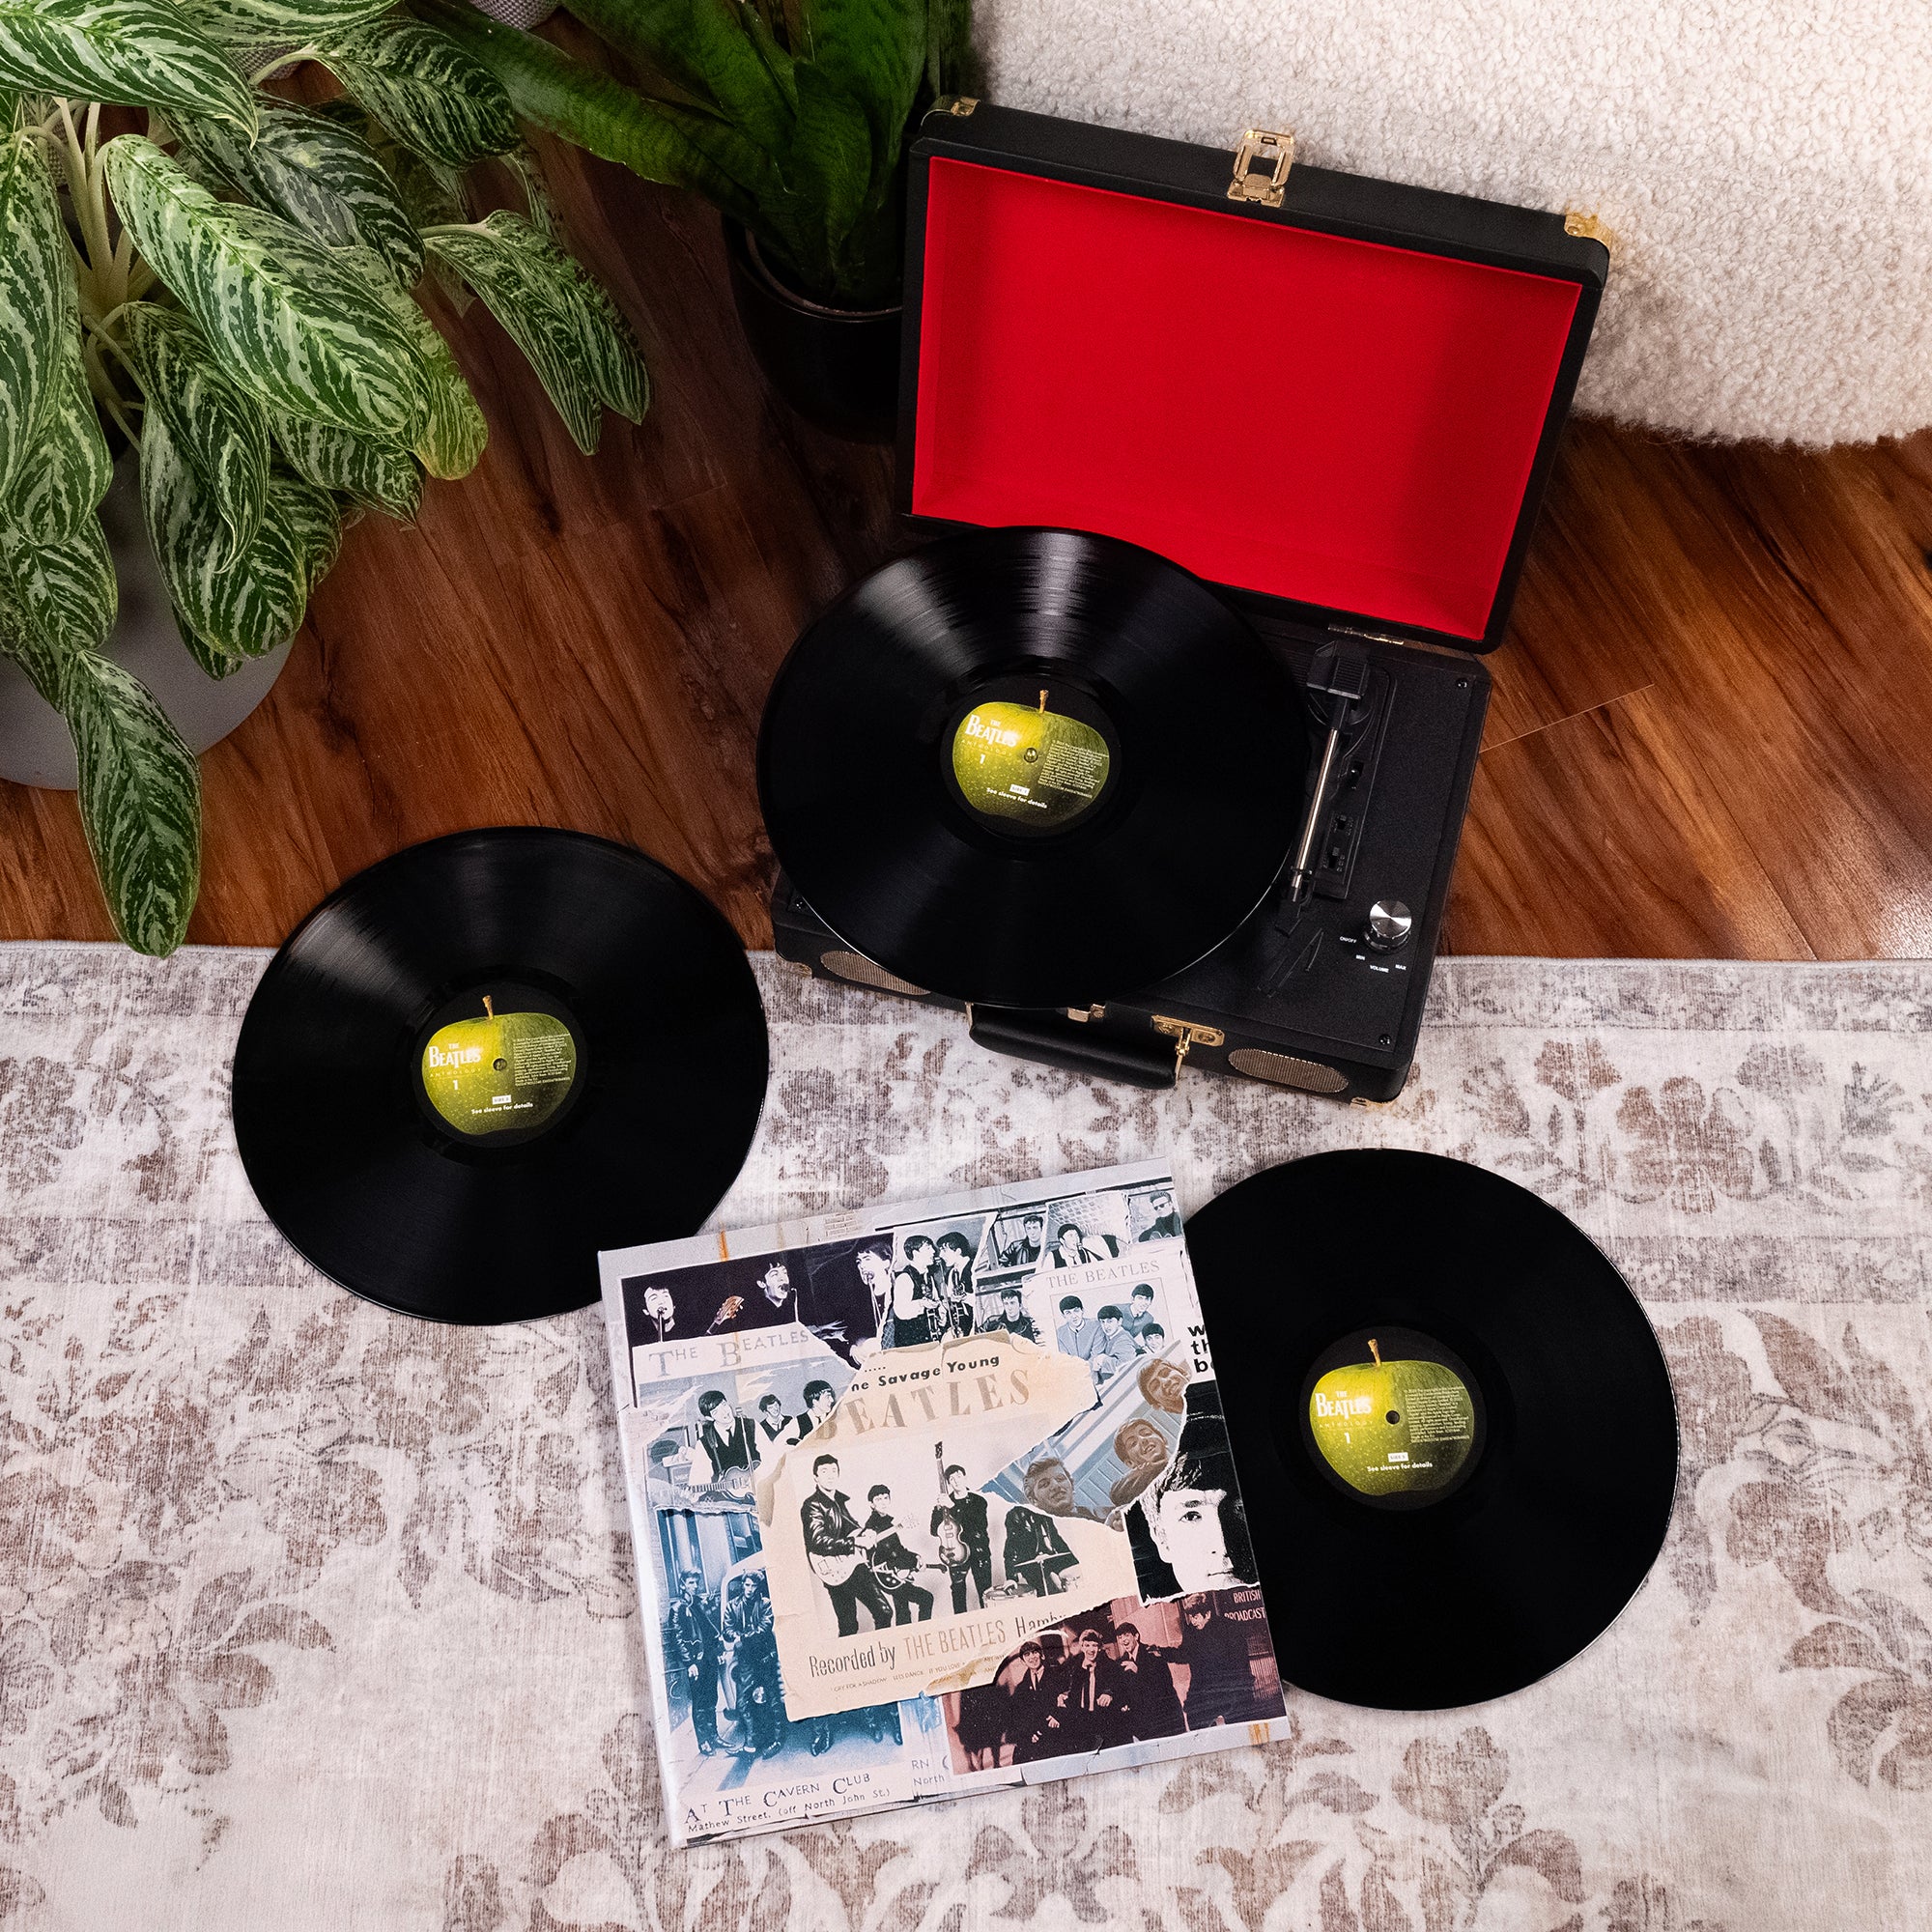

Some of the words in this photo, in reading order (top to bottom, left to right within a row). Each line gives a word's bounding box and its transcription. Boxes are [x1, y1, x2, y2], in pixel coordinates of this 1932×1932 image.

[980, 753, 985, 764] 1
[986, 787, 997, 796] See
[998, 789, 1017, 800] sleeve
[1027, 798, 1047, 809] details
[1369, 964, 1389, 974] VOLUME
[452, 1079, 459, 1091] 1
[1046, 1272, 1078, 1289] THE
[1085, 1260, 1160, 1283] BEATLES
[648, 1347, 698, 1378] THE
[716, 1329, 810, 1368] BEATLES
[878, 1366, 941, 1387] Savage
[947, 1355, 1000, 1373] Young
[1344, 1432, 1350, 1444] 1
[1233, 1589, 1262, 1604] BRITISH
[809, 1644, 876, 1677] Recorded
[879, 1640, 896, 1670] by
[903, 1636, 934, 1662] THE
[939, 1619, 1007, 1655] BEATLES
[913, 1774, 945, 1785] North
[685, 1803, 708, 1824] AT
[718, 1795, 753, 1817] THE
[763, 1782, 821, 1807] CAVERN
[832, 1773, 870, 1794] CLUB
[688, 1819, 730, 1833] Mathew
[778, 1805, 797, 1817] (off
[805, 1799, 836, 1811] North
[842, 1793, 866, 1804] John
